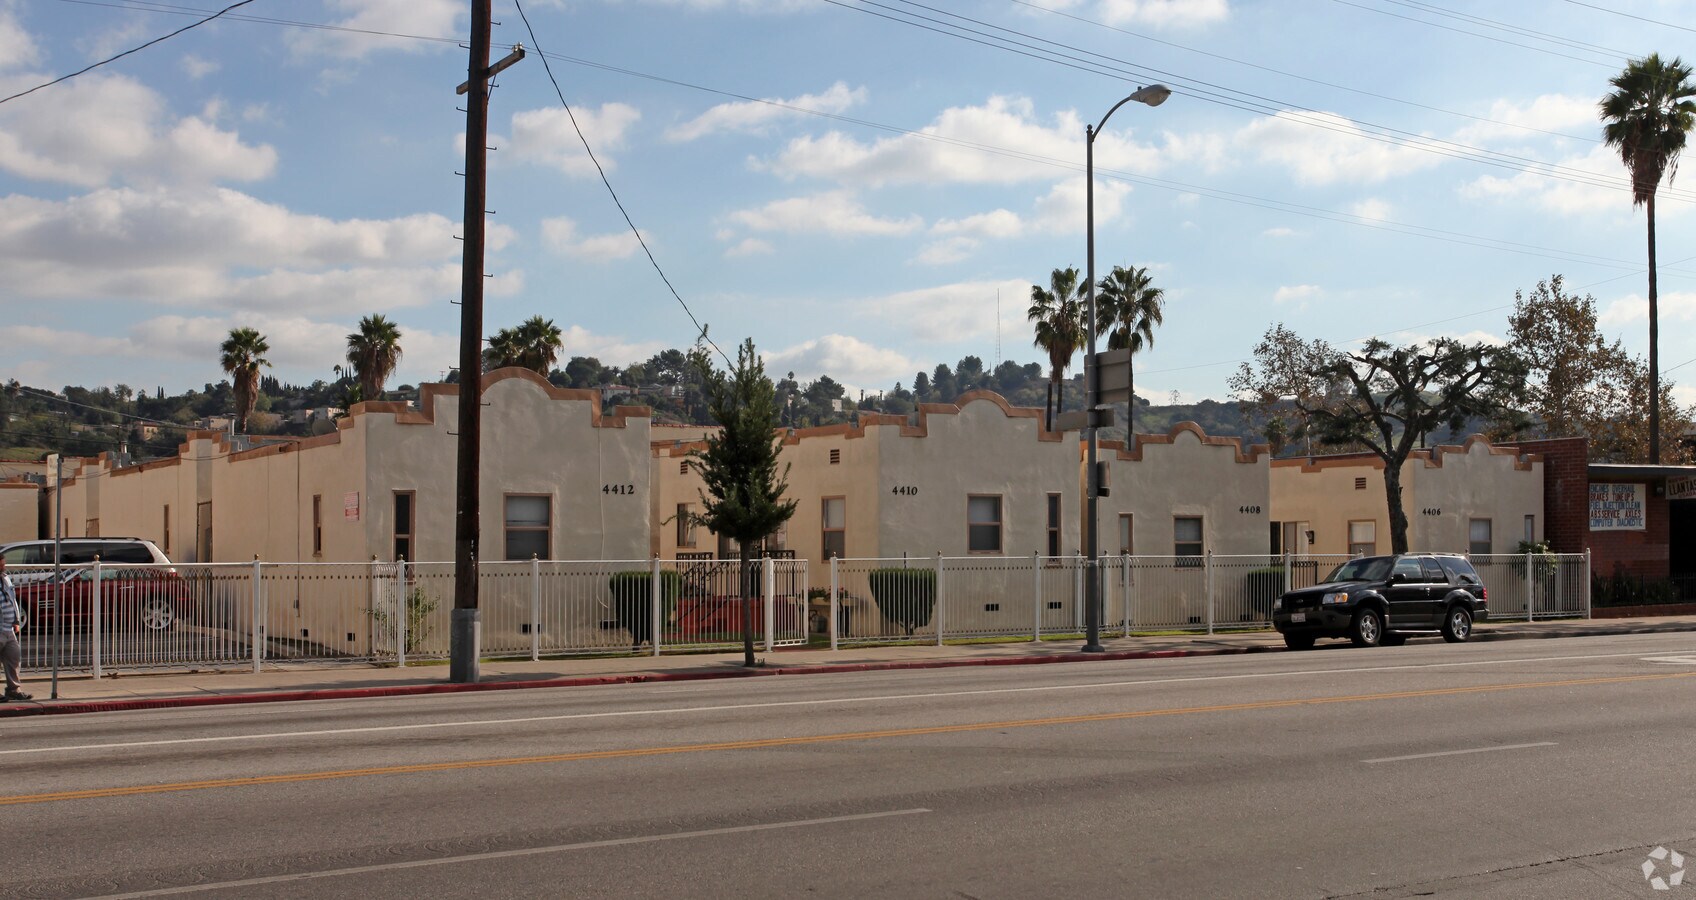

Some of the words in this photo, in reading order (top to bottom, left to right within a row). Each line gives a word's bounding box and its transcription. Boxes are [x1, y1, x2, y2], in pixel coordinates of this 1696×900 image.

[602, 484, 635, 495] 4412
[892, 486, 918, 496] 4410
[1590, 492, 1609, 501] BRAKES
[1239, 505, 1261, 514] 4408
[1590, 501, 1602, 510] FUEL
[1422, 507, 1441, 516] 4406
[1625, 509, 1641, 518] AXLES
[1590, 518, 1613, 527] COMPUTER
